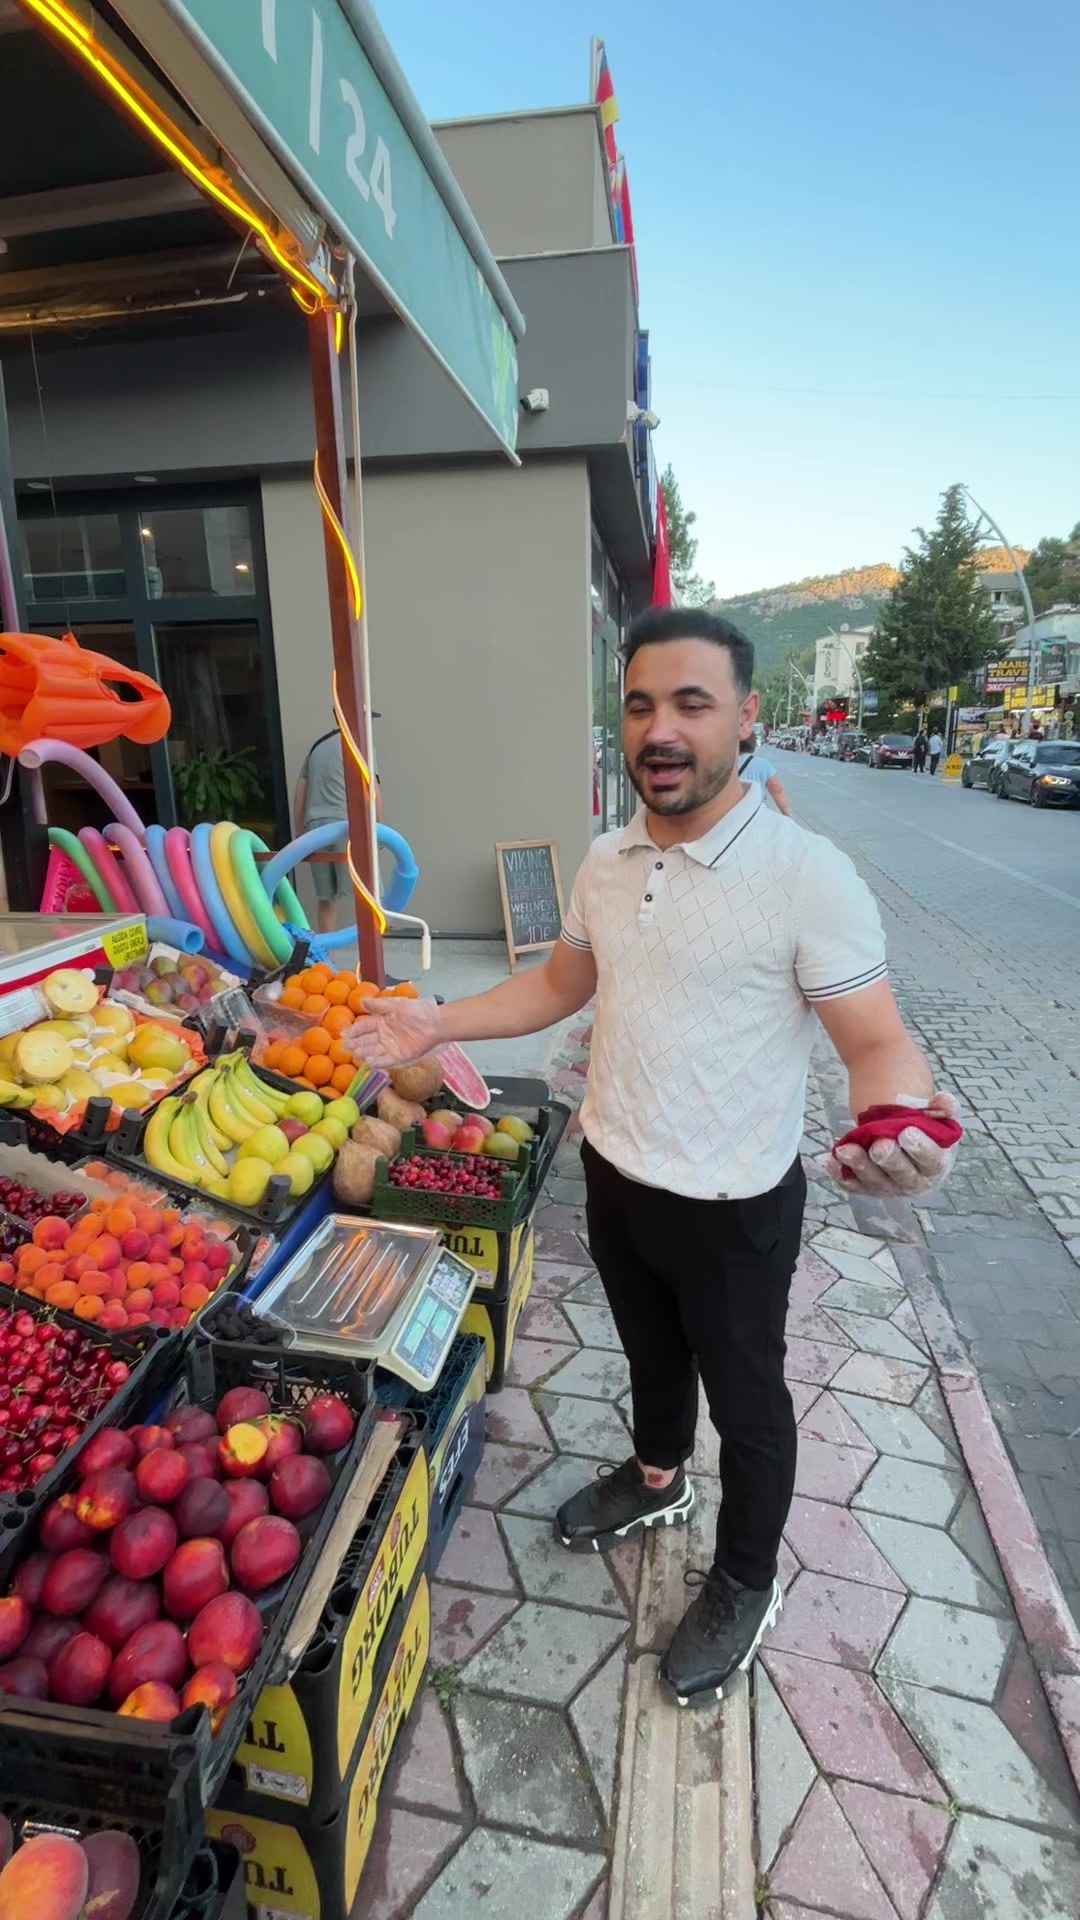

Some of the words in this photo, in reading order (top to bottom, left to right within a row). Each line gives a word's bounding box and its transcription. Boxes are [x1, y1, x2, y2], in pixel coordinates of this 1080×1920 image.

[988, 668, 1028, 677] TRAVE
[998, 660, 1028, 669] MARS
[505, 848, 549, 872] VIKING
[513, 871, 552, 888] BEACH
[511, 899, 557, 913] WELLNESS
[515, 911, 558, 926] MASSAGE
[437, 1423, 471, 1505] EFES
[352, 1501, 421, 1697] TUBORG
[358, 1624, 422, 1838] TUBORG
[243, 1859, 294, 1895] TU
